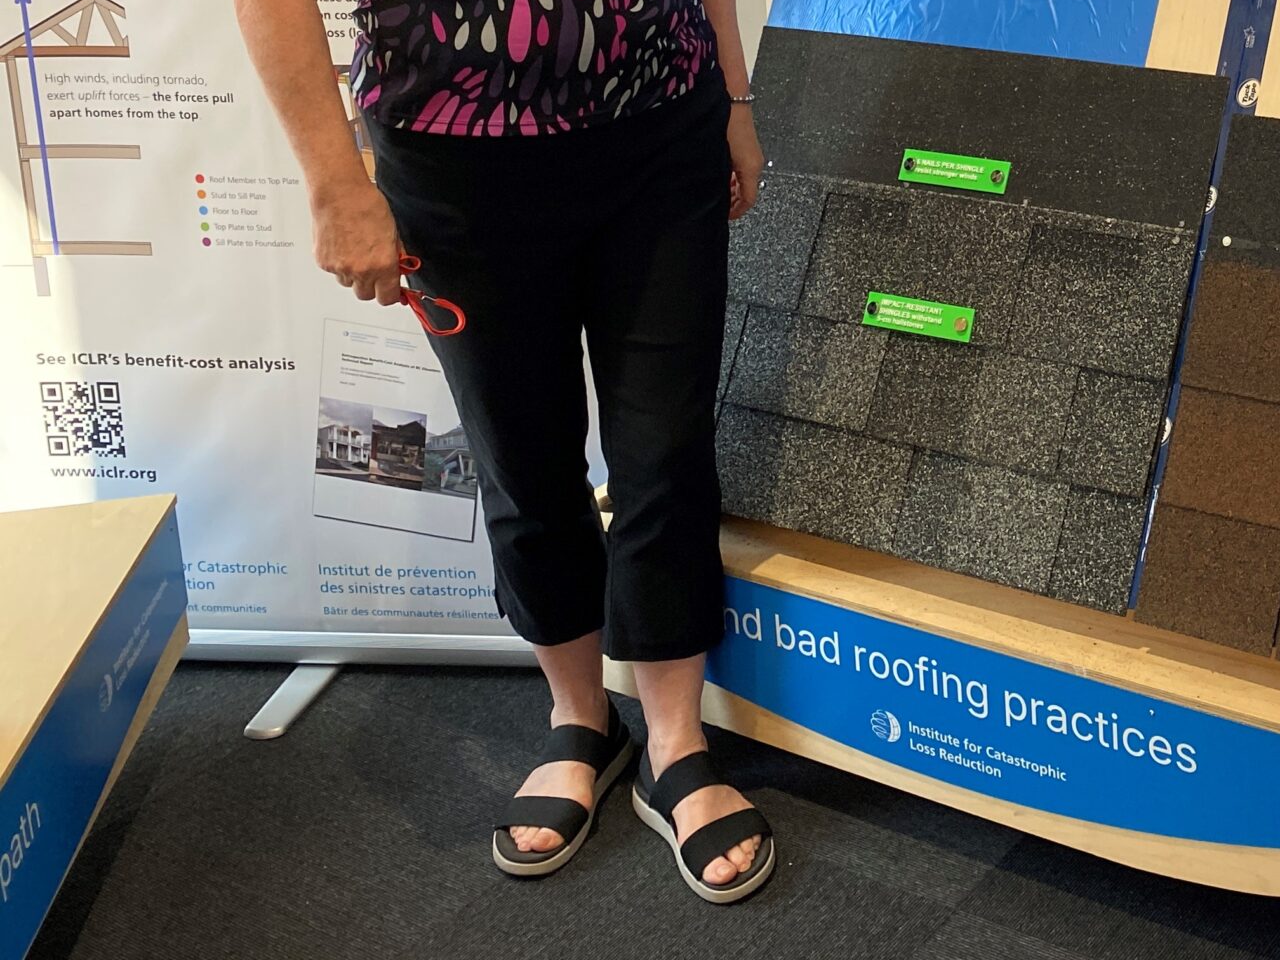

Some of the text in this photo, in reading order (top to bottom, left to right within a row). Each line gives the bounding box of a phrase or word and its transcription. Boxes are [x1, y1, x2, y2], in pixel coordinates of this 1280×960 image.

[45, 73, 208, 86] High winds, including tornado,
[50, 109, 82, 120] apart
[85, 107, 123, 118] homes
[126, 108, 154, 119] from
[157, 109, 176, 119] the
[956, 163, 985, 173] SHINGLE
[37, 353, 66, 365] See
[125, 354, 224, 369] benefit-cost
[228, 356, 296, 372] analysis
[51, 467, 157, 482] www.iclr.org
[198, 561, 288, 575] Catastrophic
[318, 564, 476, 580] Institut de prévention
[320, 581, 345, 594] des
[348, 582, 406, 595] sinistres
[201, 604, 267, 614] communities
[323, 606, 348, 616] Bâtir
[351, 607, 369, 616] des
[447, 611, 499, 620] résilientes
[775, 613, 840, 665] bad
[854, 644, 989, 719] roofing
[1003, 688, 1199, 774] practices
[908, 721, 1067, 782] Institute for Catastrophic
[909, 739, 1002, 778] Loss Reduction
[0, 801, 41, 902] path
